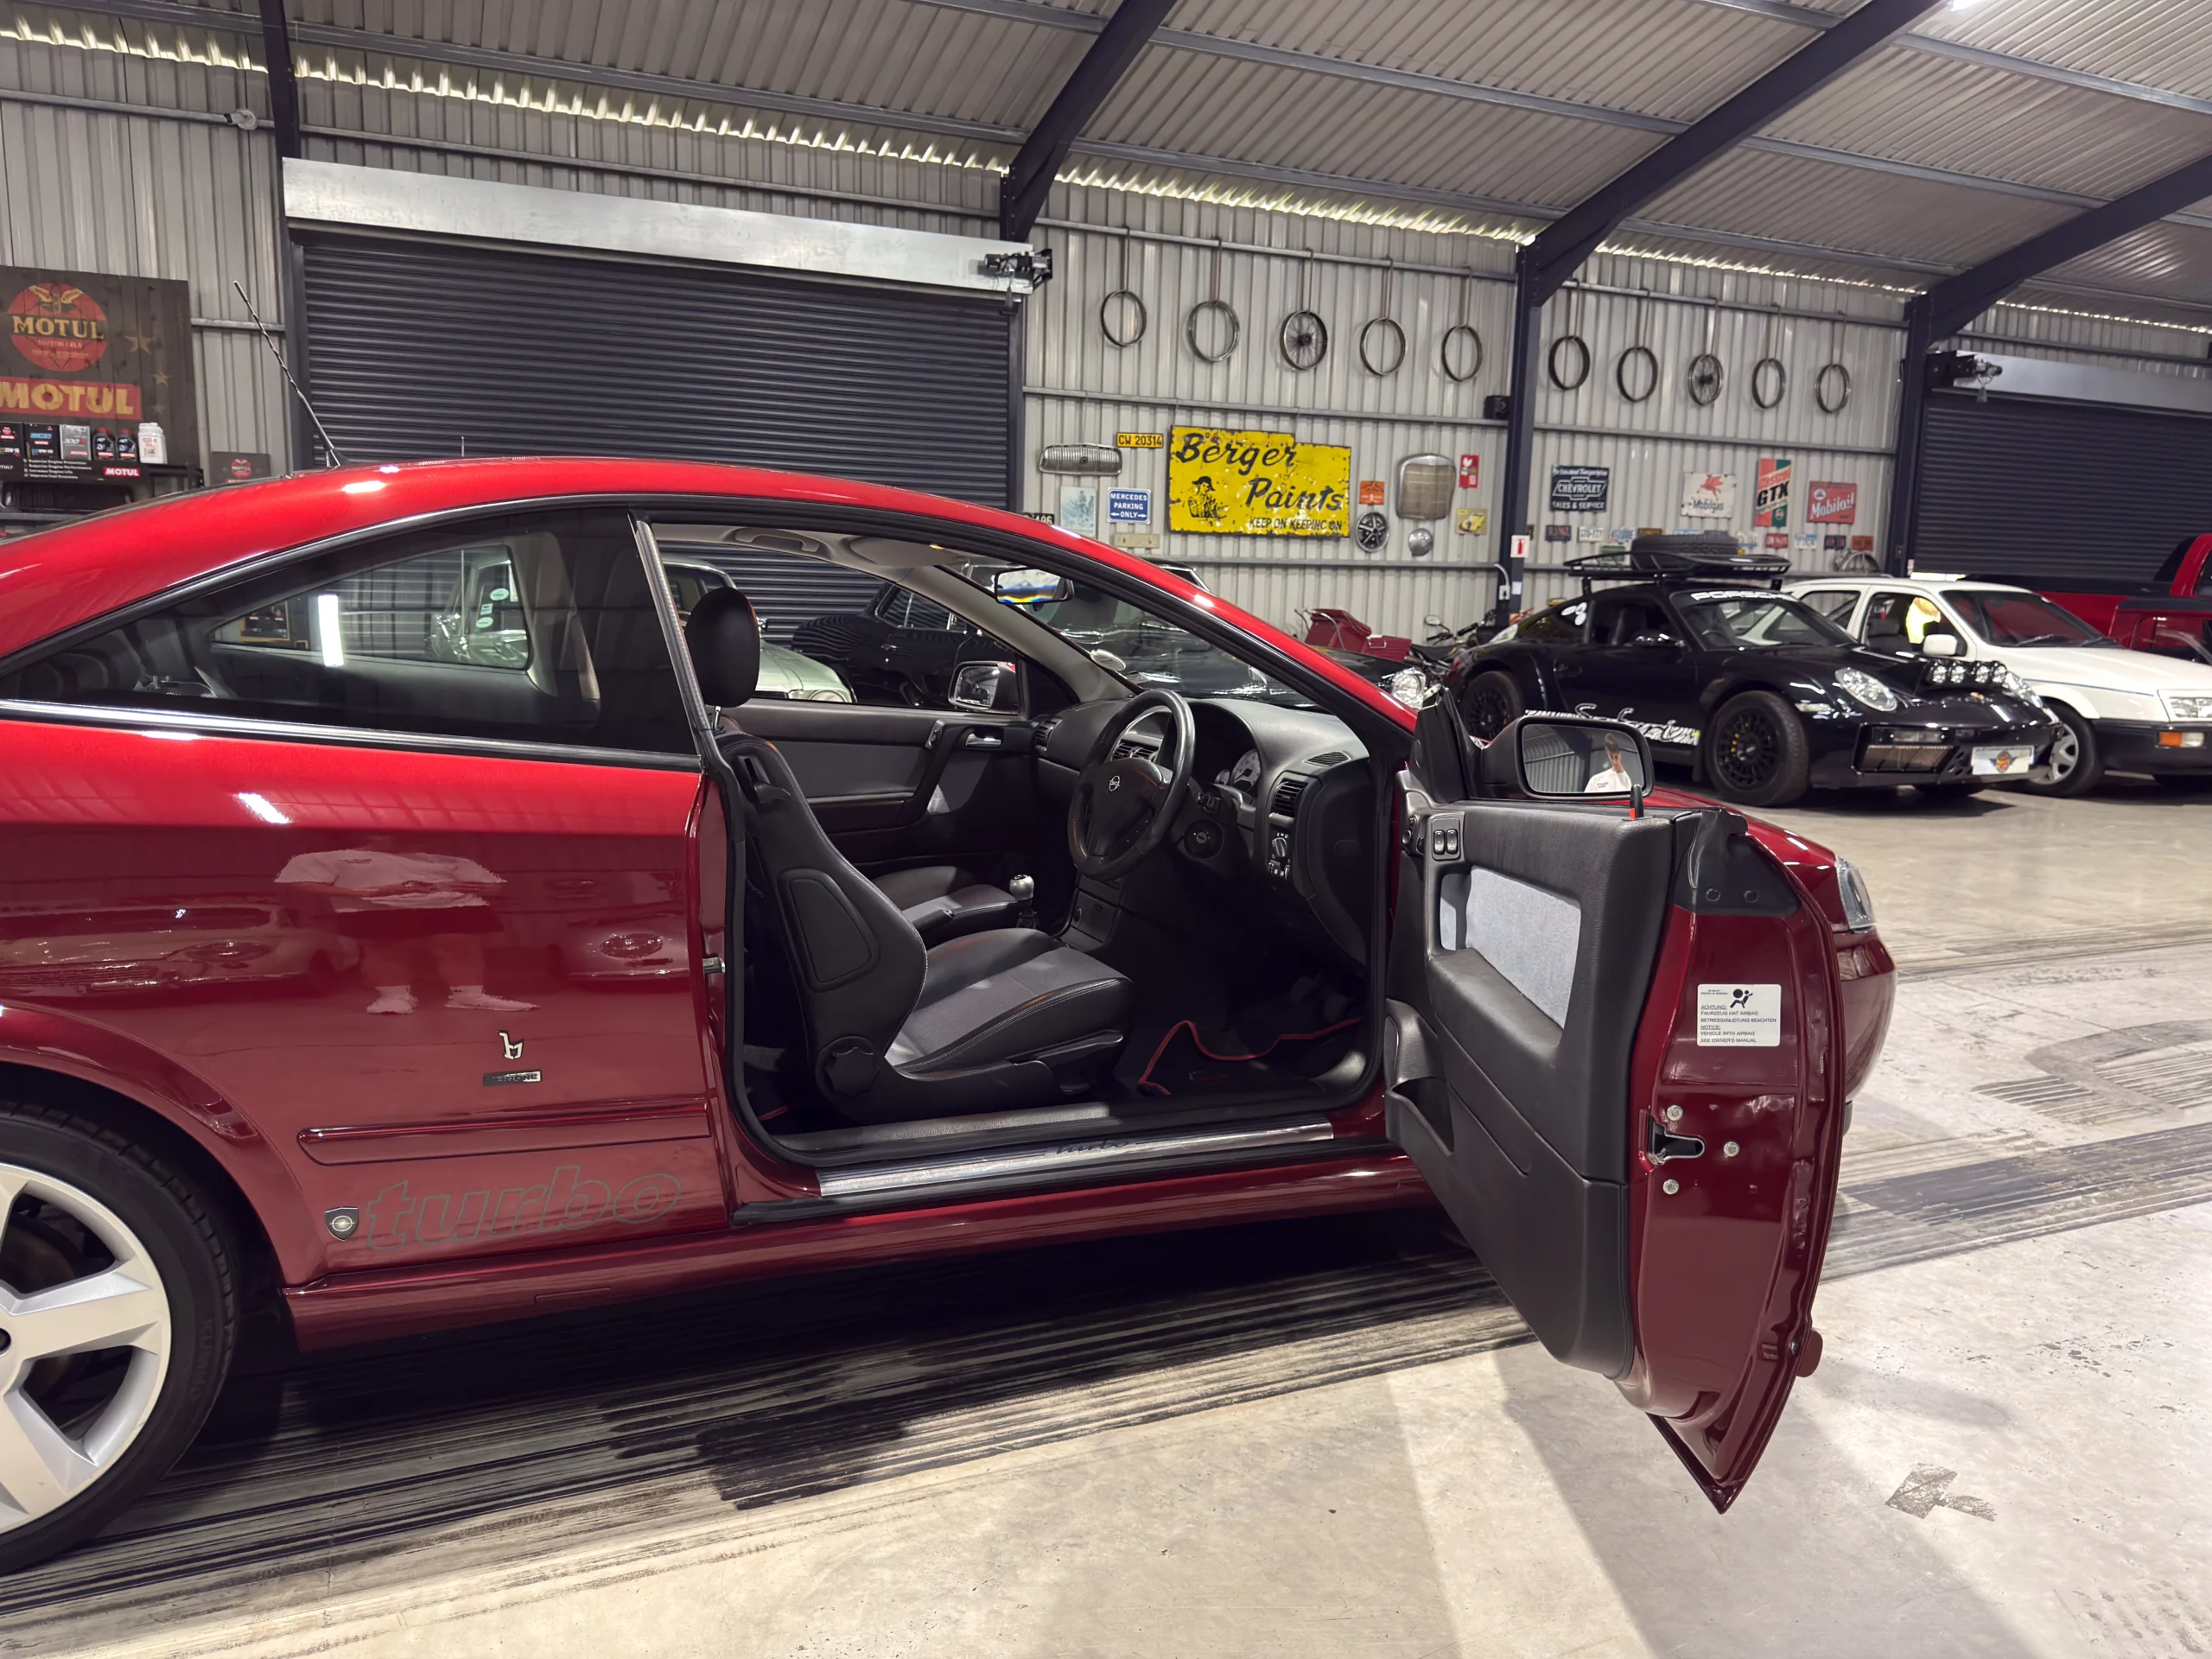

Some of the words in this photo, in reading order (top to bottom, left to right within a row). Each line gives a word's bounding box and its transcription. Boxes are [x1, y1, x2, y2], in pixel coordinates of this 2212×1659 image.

[12, 315, 105, 340] MOTUL
[0, 381, 134, 415] MOTUL
[1118, 435, 1131, 444] CW
[1135, 435, 1162, 446] 20314
[1176, 432, 1297, 475] Berger
[105, 467, 140, 476] MOTUL
[1245, 477, 1344, 511] Paints
[1558, 484, 1601, 493] CHEVROLET
[1757, 480, 1789, 506] GTX
[1693, 499, 1724, 513] Mobilgas
[1810, 492, 1854, 518] Mobiloil
[1249, 517, 1272, 528] KEEP
[1274, 518, 1287, 529] ON
[1328, 520, 1342, 531] ON
[366, 1165, 681, 1251] turbo
